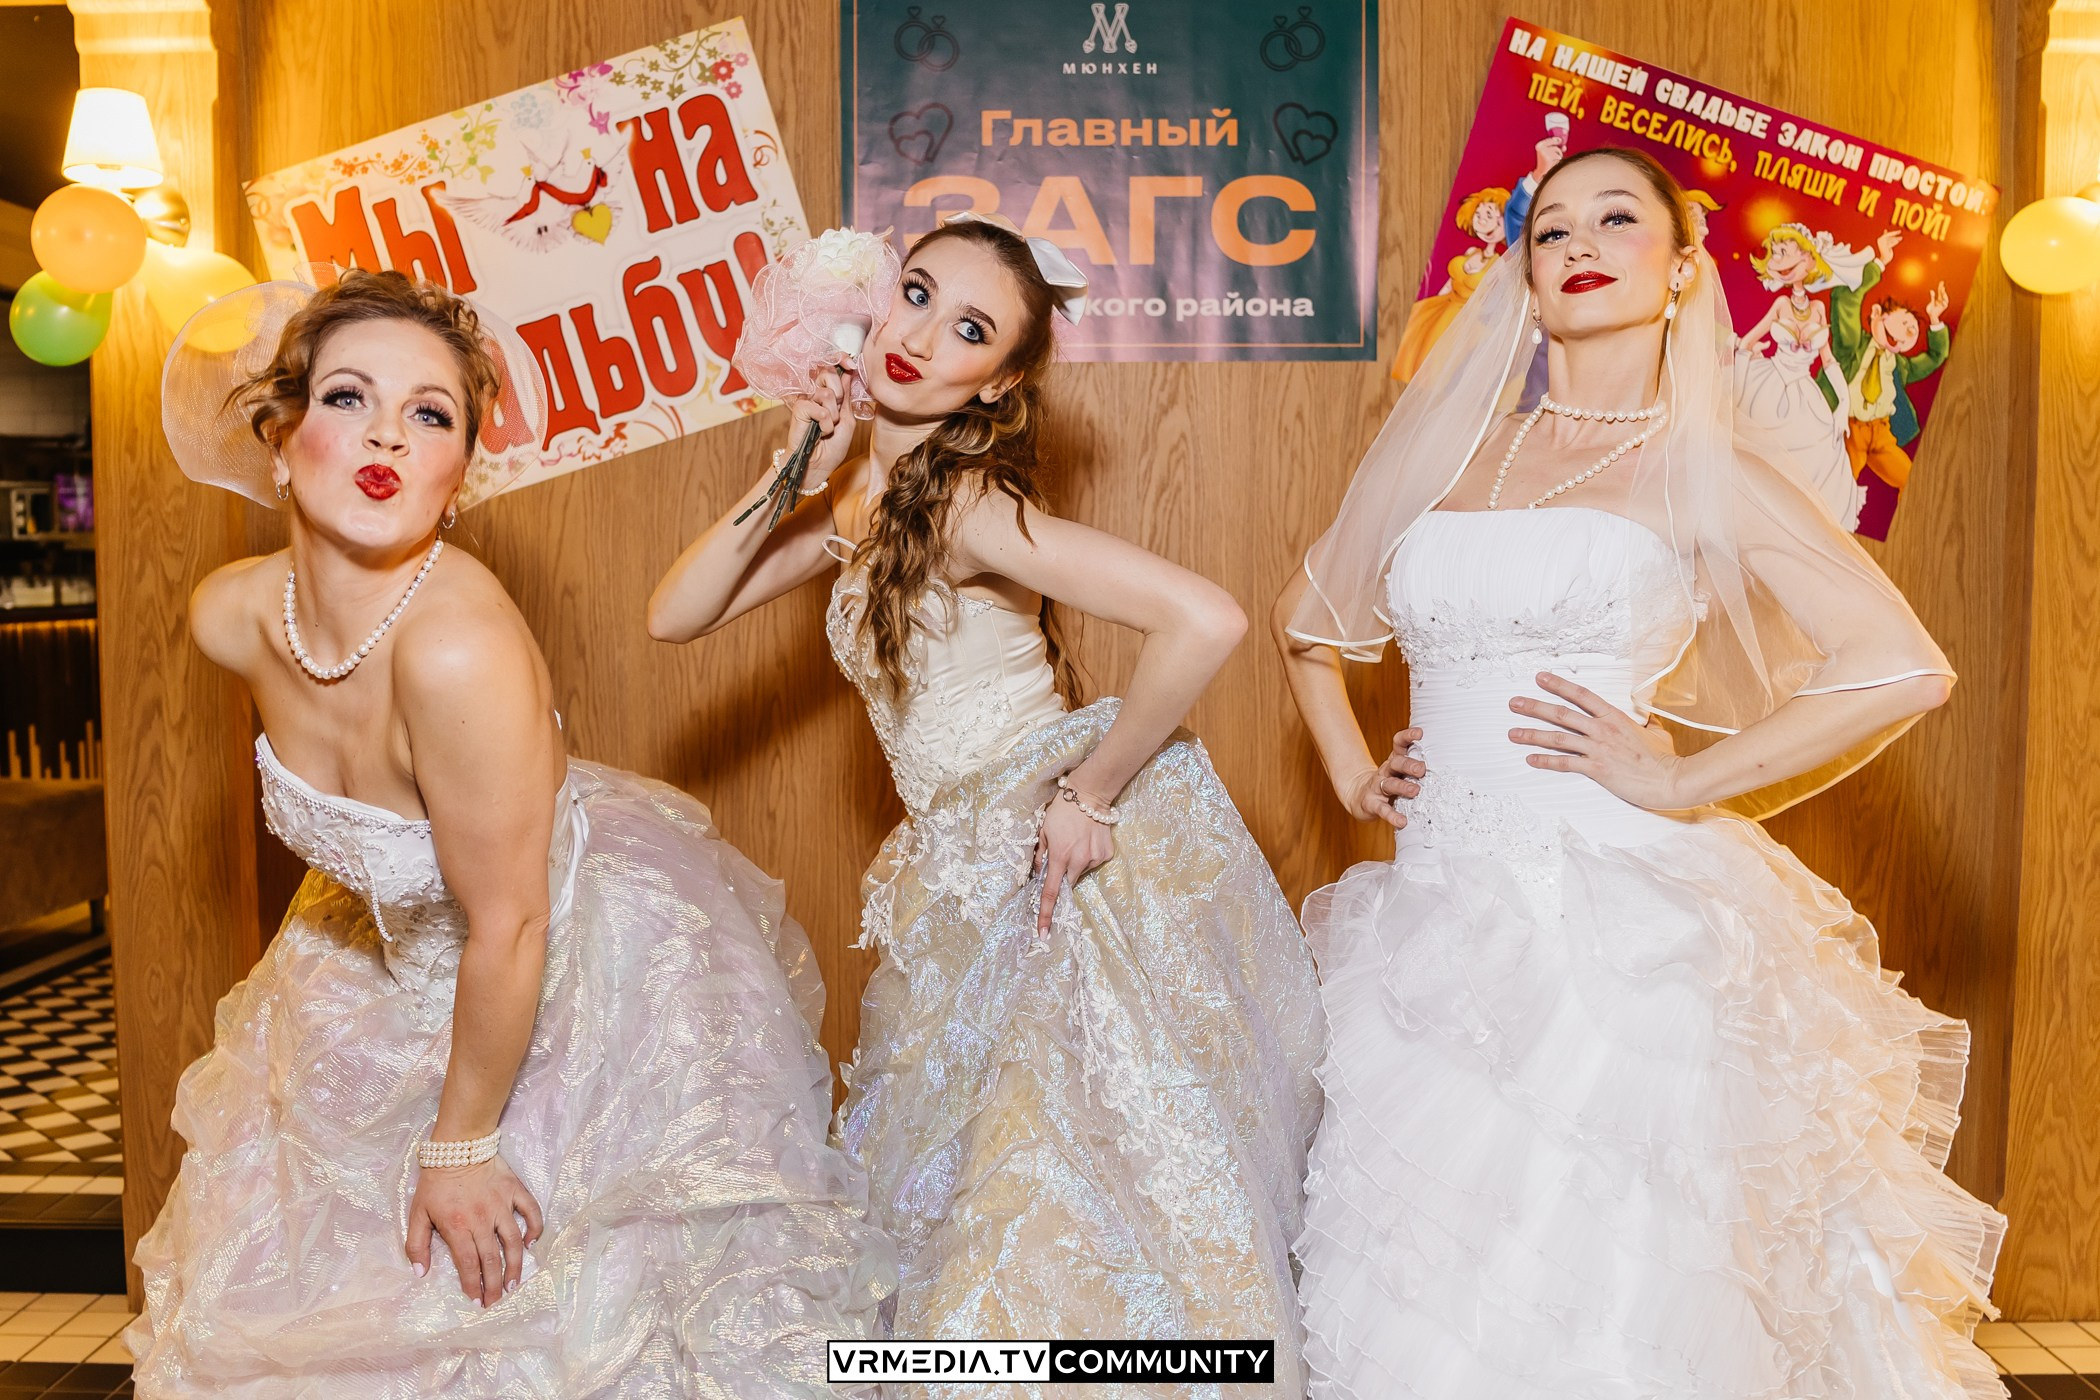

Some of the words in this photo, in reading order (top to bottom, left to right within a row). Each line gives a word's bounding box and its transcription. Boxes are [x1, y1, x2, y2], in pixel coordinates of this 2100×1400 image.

[1062, 62, 1158, 75] МЮНХЕН
[1508, 27, 1547, 62] НА
[1552, 43, 1649, 97] НАШЕЙ
[1655, 78, 1772, 140] СВАДЬБЕ
[1777, 121, 1864, 172] ЗАКОН
[980, 108, 1238, 147] Главный
[1528, 72, 1584, 120] ПЕЙ,
[1600, 95, 1737, 173] ВЕСЕЛИСЬ,
[1754, 150, 1848, 206] ПЛЯШИ
[1857, 185, 1881, 218] И
[1891, 197, 1952, 242] ПОЙ!
[903, 175, 1317, 267] ЗАГС
[1176, 292, 1315, 322] района
